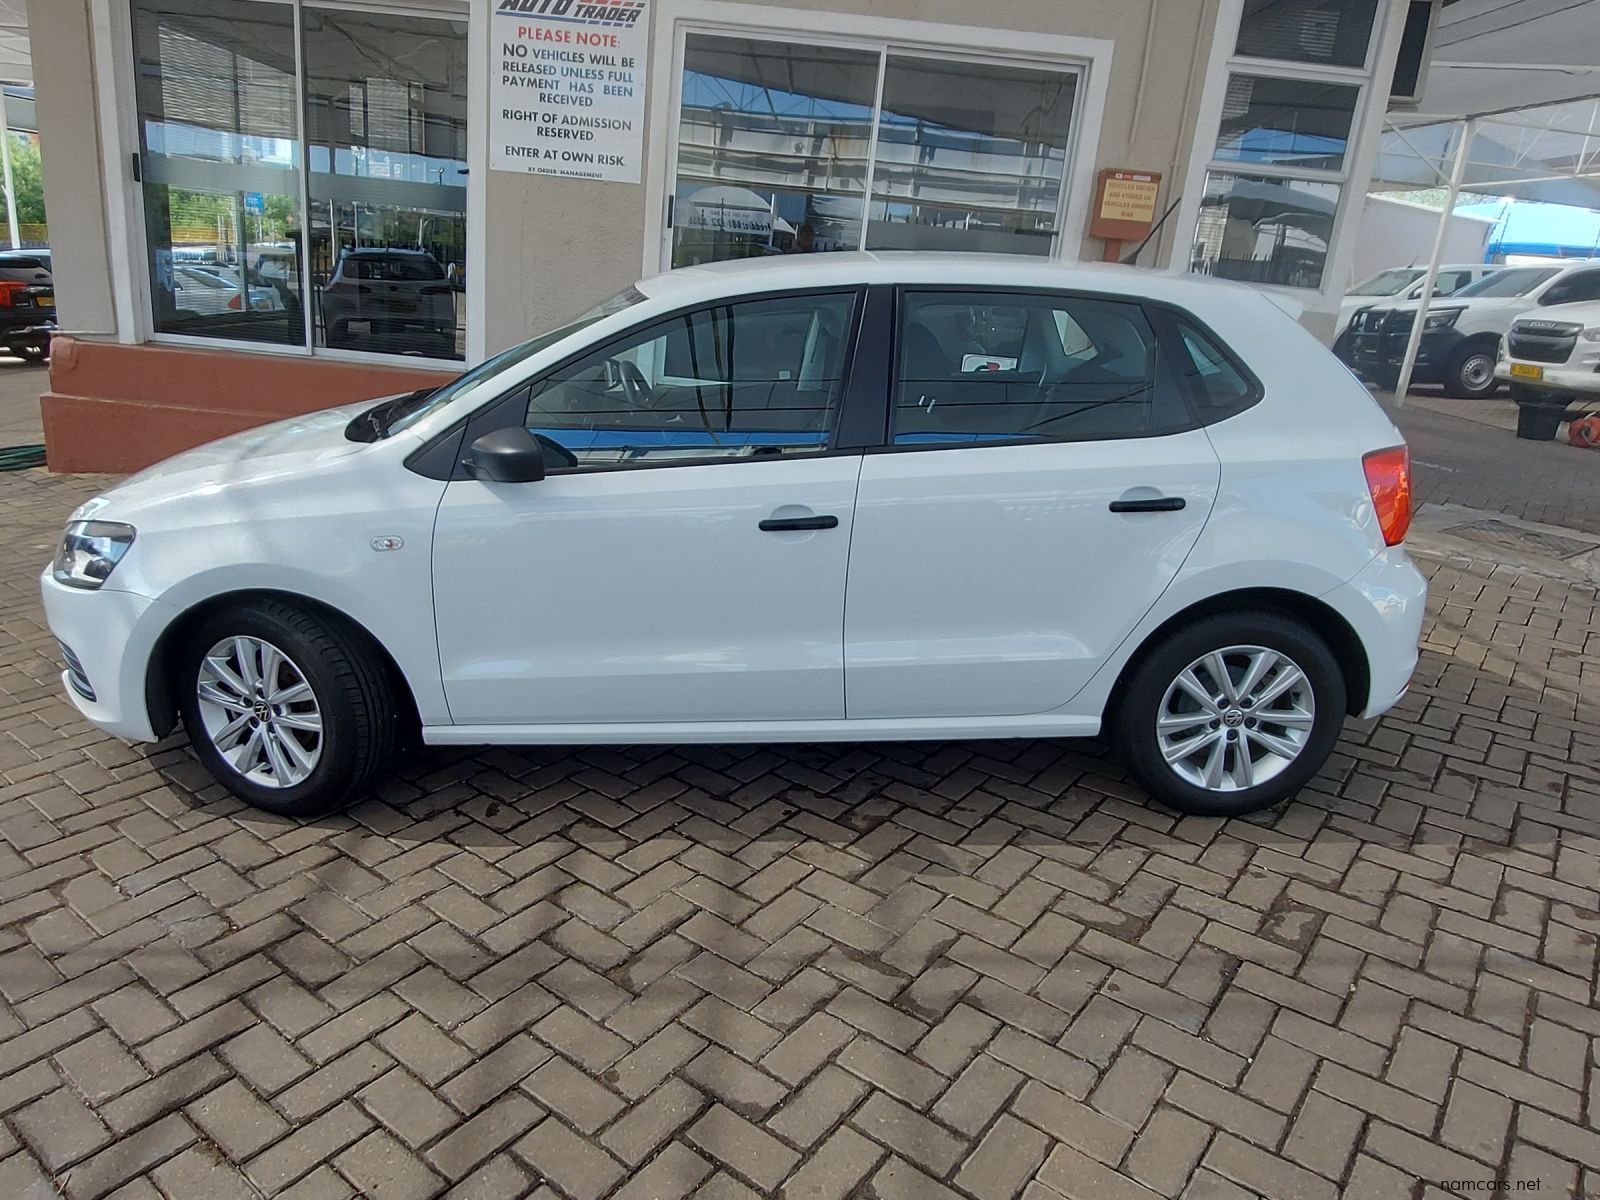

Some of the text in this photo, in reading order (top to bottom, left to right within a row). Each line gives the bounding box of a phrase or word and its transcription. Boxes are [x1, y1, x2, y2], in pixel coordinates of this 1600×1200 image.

[573, 4, 642, 23] TRADER
[517, 26, 621, 49] PLEASE NOTE:
[503, 43, 635, 69] NO VEHICLES WILL BE
[502, 61, 634, 84] RELEASED UNLESS FULL
[502, 75, 633, 97] PAYMENT HAS BEEN
[539, 93, 594, 107] RECEIVED
[502, 109, 632, 131] RIGHT OF ADMISSION
[505, 145, 540, 159] ENTER
[543, 149, 558, 160] AT
[561, 151, 594, 164] OWN
[560, 169, 603, 179] MANAGEMENT
